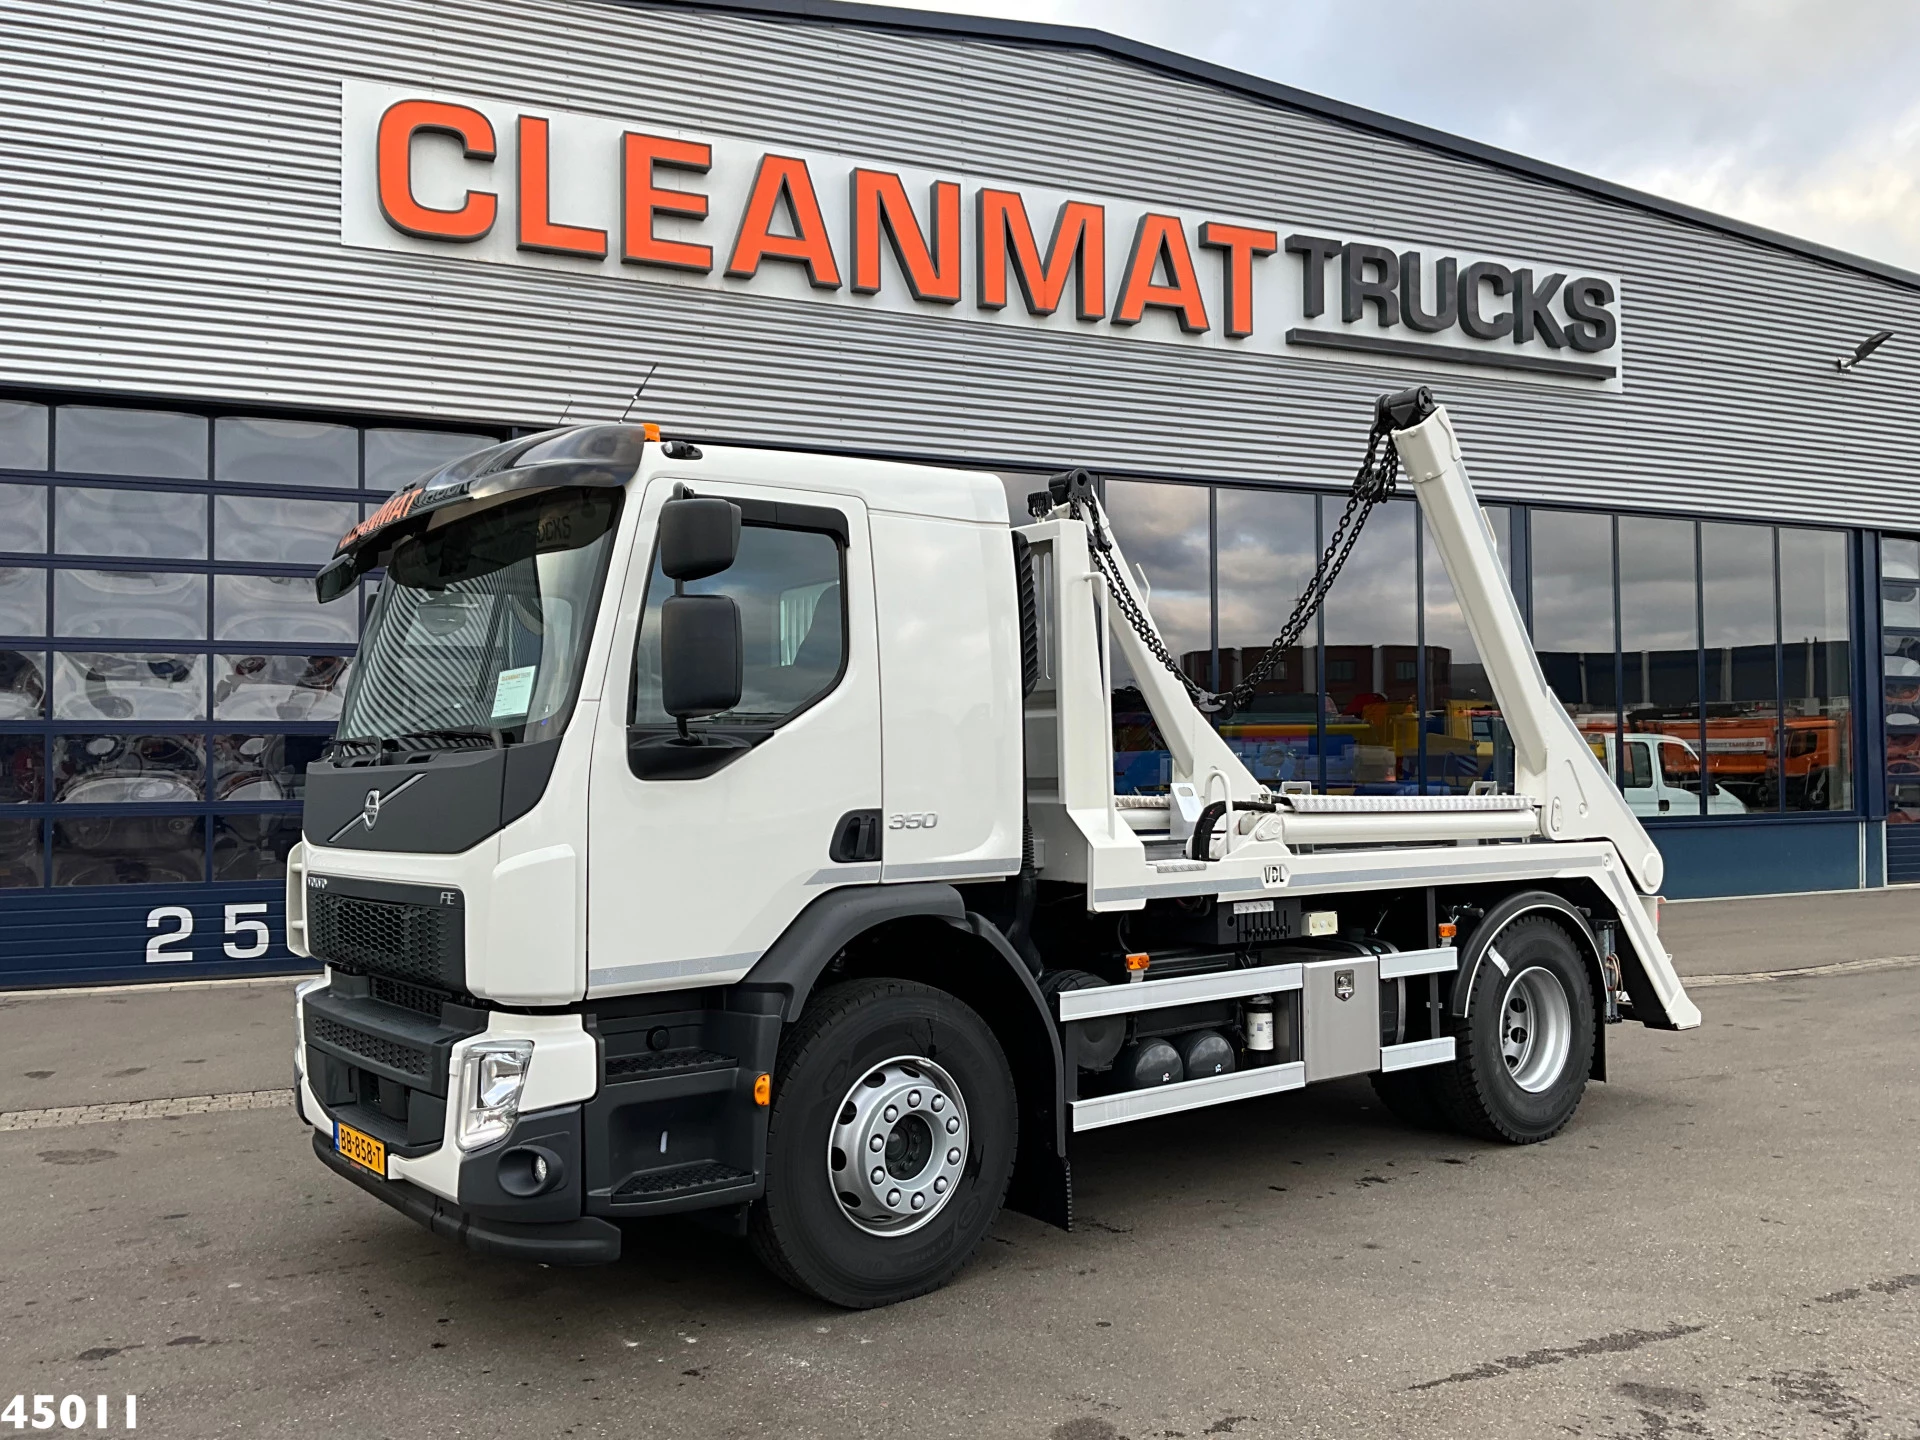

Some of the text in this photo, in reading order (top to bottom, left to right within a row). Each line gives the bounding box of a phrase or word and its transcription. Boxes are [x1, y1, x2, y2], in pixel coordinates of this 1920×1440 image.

[376, 99, 1618, 354] CLEANMAT TRUCKS
[888, 812, 939, 830] 350
[1263, 865, 1285, 884] VDL
[440, 891, 457, 905] FE
[340, 1127, 382, 1170] BB-858-T
